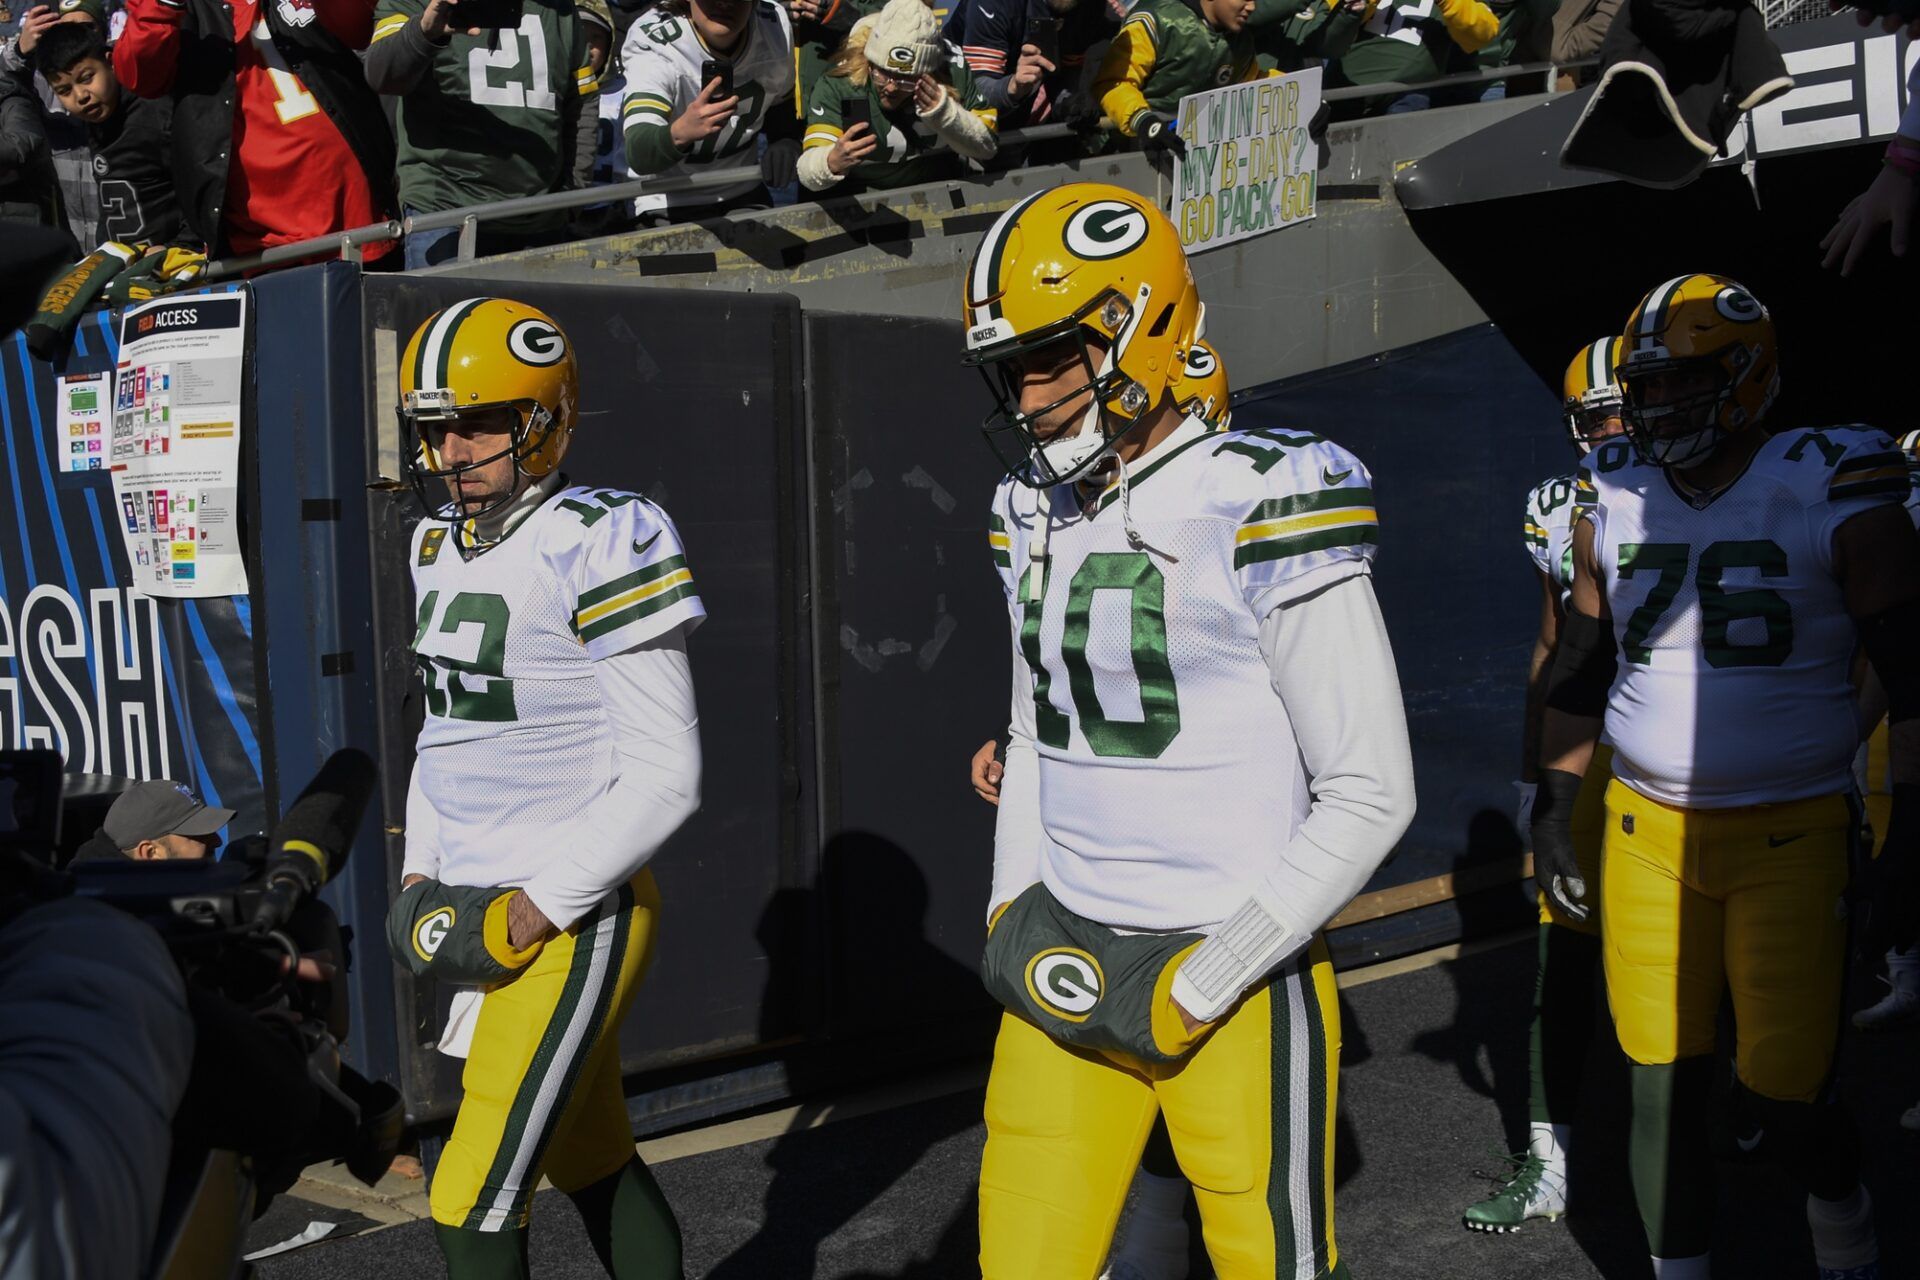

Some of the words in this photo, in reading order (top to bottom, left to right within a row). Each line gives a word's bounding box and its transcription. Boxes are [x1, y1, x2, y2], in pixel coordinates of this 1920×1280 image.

[468, 13, 556, 111] 21
[1182, 98, 1198, 147] A
[1208, 87, 1254, 144] WIN
[1256, 81, 1299, 135] FOR
[1710, 34, 1920, 163] EI
[1180, 144, 1219, 201] MY
[1221, 127, 1308, 189] B-DAY?
[1066, 201, 1147, 257] G
[1180, 193, 1215, 246] GO
[1217, 177, 1277, 238] PACK
[1281, 169, 1316, 222] GO!
[155, 308, 198, 328] ACCESS
[509, 319, 565, 364] G
[972, 327, 998, 343] PACKERS
[419, 391, 440, 401] PACKERS
[1616, 539, 1793, 670] 76
[411, 590, 519, 723] 12
[1016, 552, 1182, 760] 10
[421, 911, 454, 955] G
[1034, 953, 1101, 1013] G
